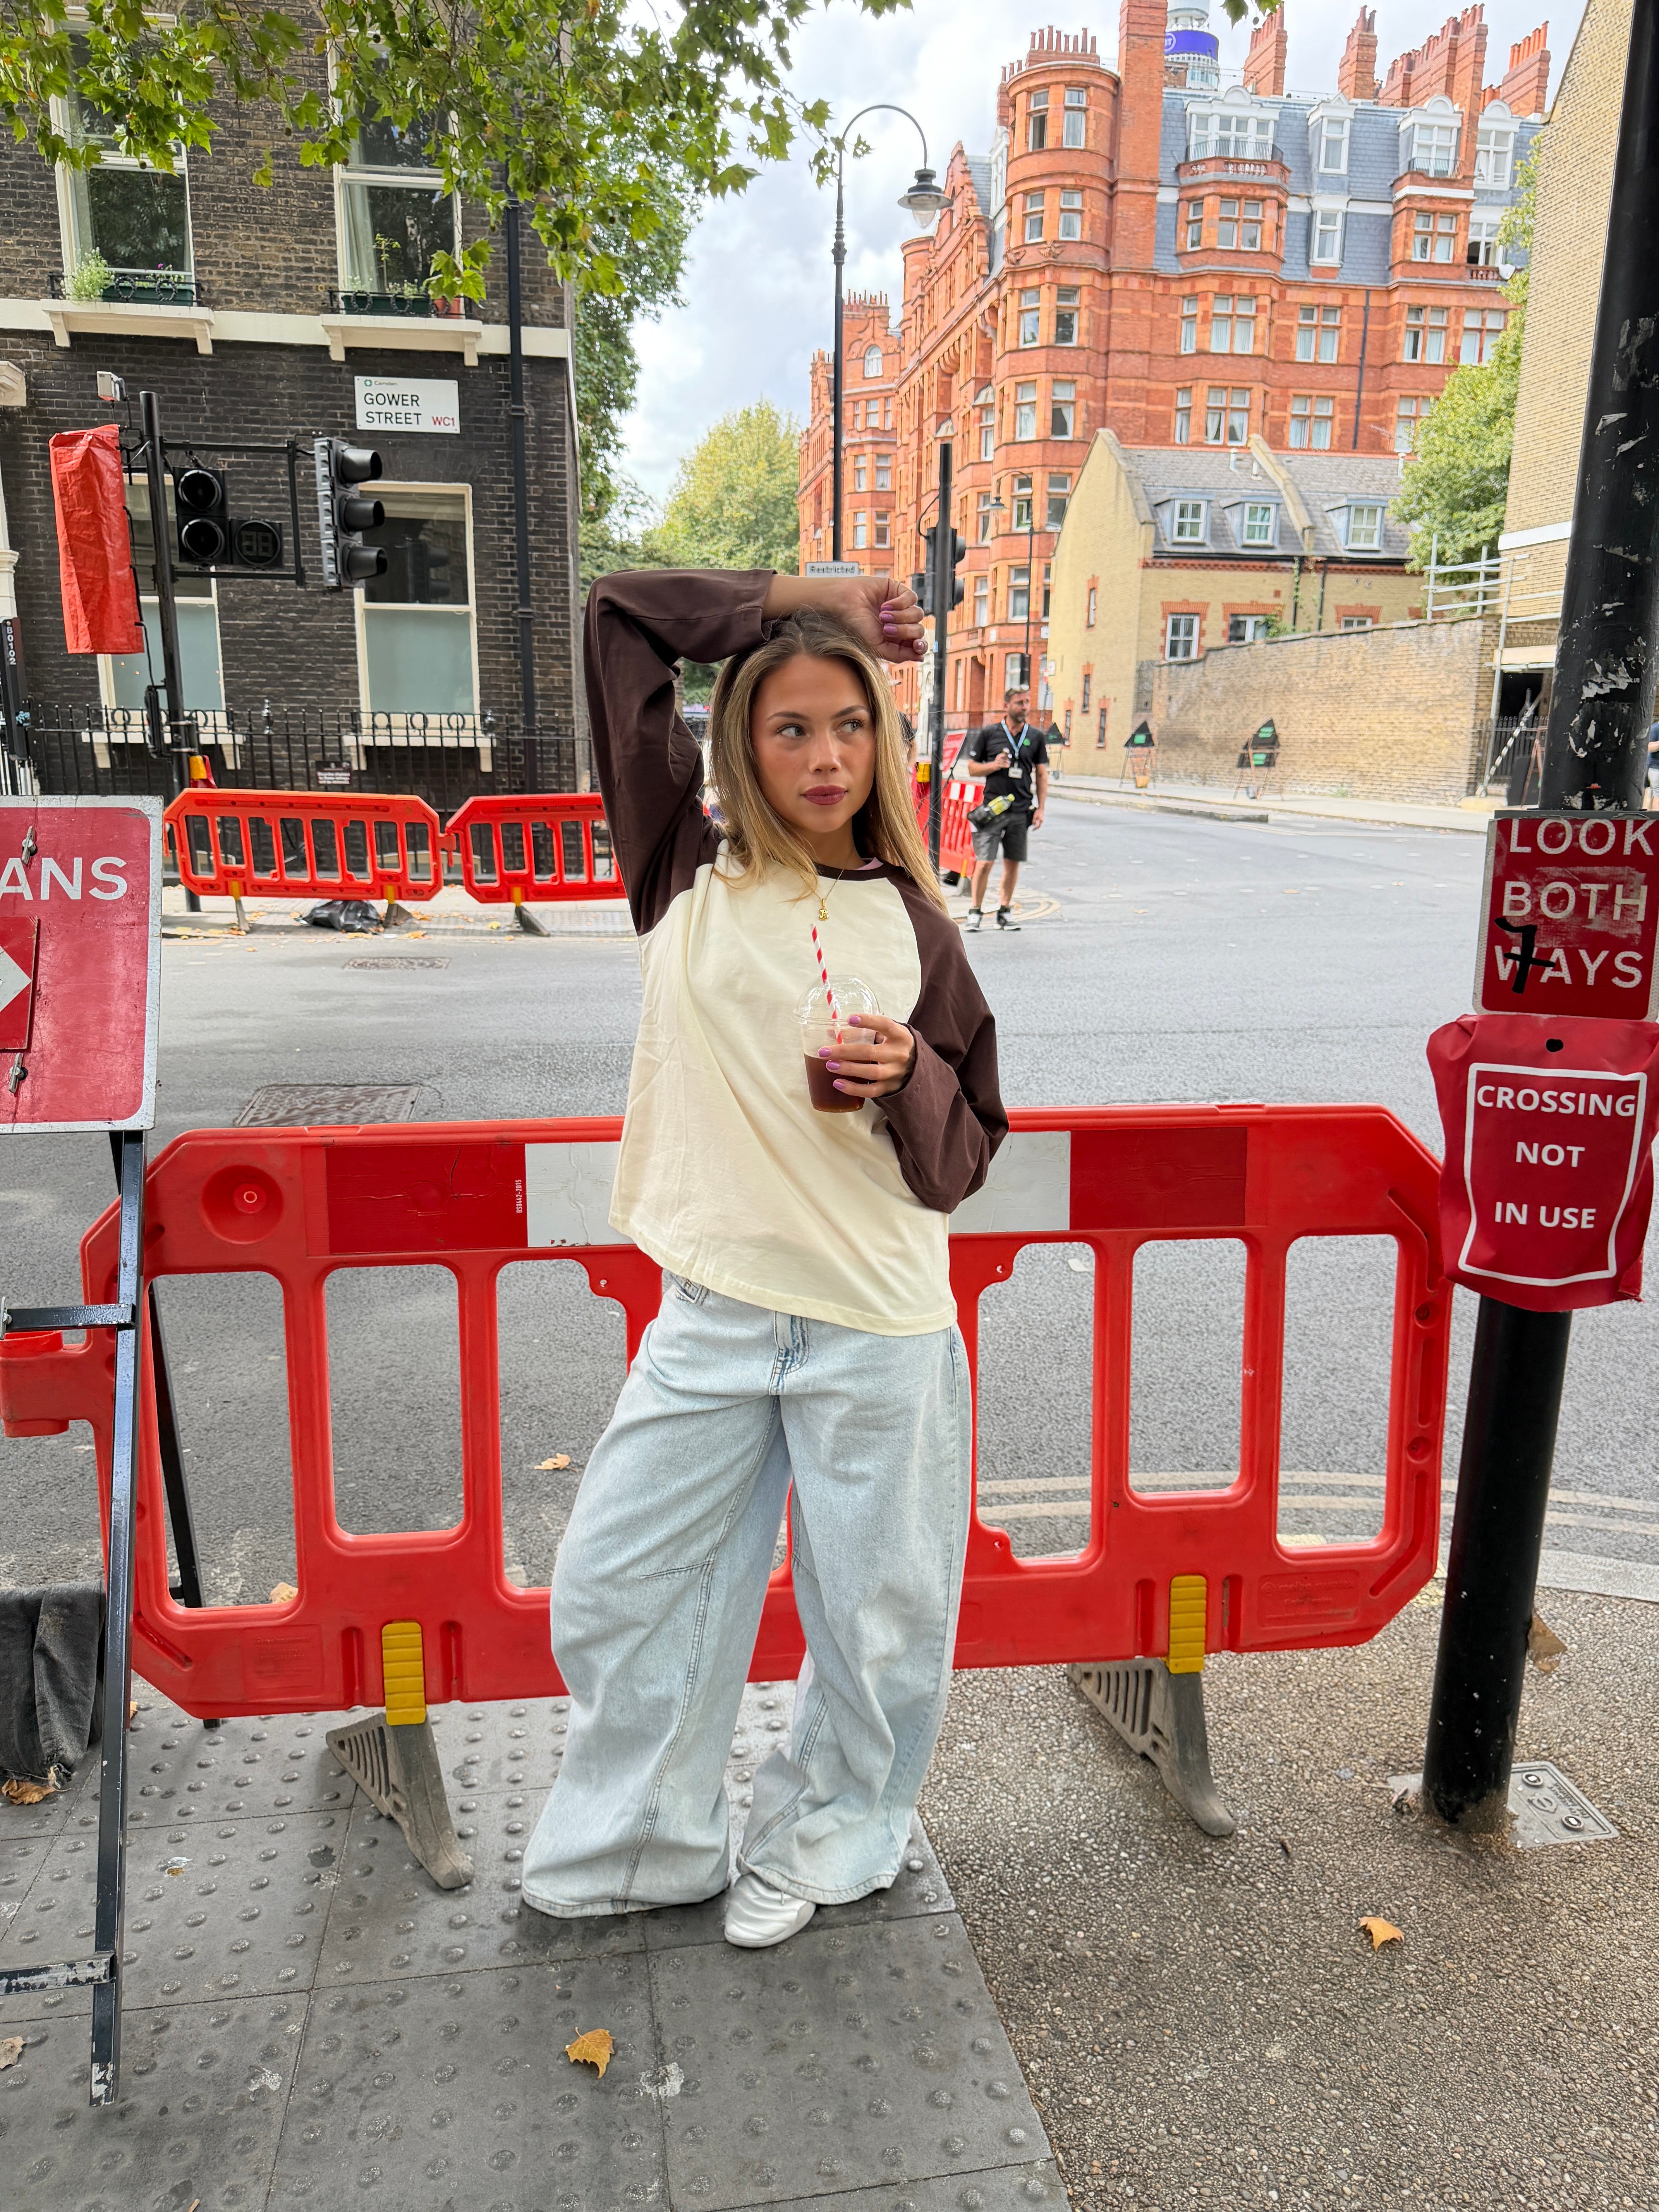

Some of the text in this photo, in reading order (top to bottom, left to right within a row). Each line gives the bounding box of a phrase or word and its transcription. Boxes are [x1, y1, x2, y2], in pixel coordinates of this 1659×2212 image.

[364, 393, 420, 407] GOWER
[366, 411, 455, 426] STREET WC1
[1510, 818, 1657, 856] LOOK
[0, 856, 127, 900] ANS
[1502, 881, 1648, 921] BOTH
[1494, 945, 1644, 988] WAYS
[1477, 1085, 1636, 1117] CROSSING
[1516, 1141, 1585, 1168] NOT
[1495, 1202, 1596, 1229] IN USE
